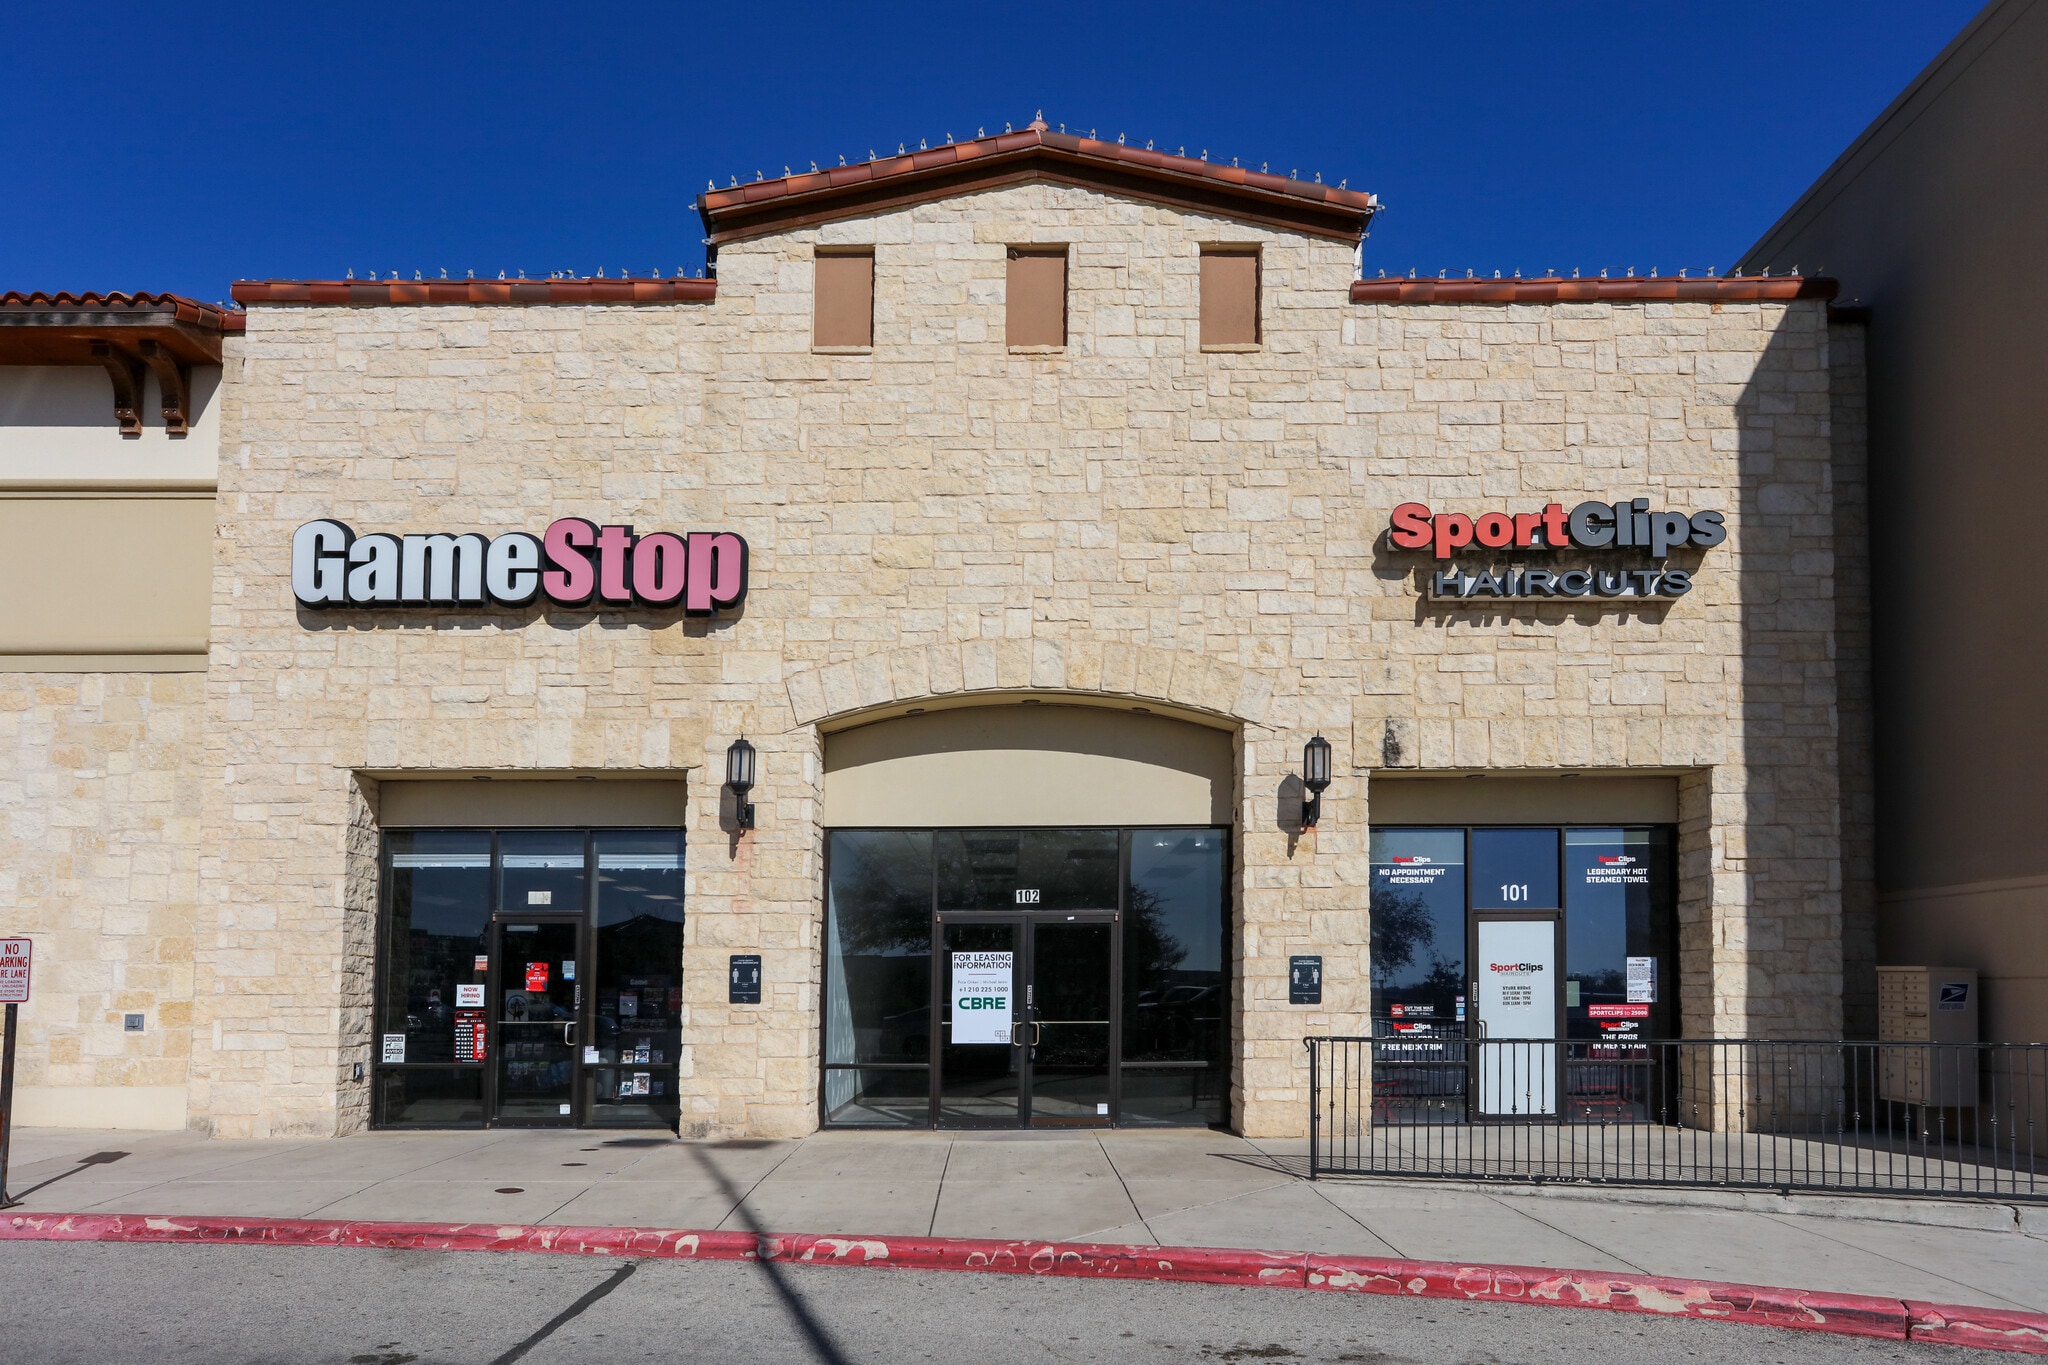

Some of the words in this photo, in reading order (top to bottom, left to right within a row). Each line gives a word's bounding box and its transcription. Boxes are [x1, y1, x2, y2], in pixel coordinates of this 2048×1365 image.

[291, 517, 749, 617] GameStop
[1434, 569, 1693, 596] HAIRCUTS
[1379, 868, 1390, 876] NO
[1391, 868, 1446, 876] APPOINTMENT
[1390, 876, 1435, 884] NECESSARY
[1018, 890, 1039, 902] 102
[1501, 885, 1528, 901] 101
[5, 944, 19, 954] NO
[0, 957, 27, 967] ARKING
[954, 954, 971, 962] FOR
[974, 954, 1012, 962] LEASING
[0, 970, 8, 978] RE
[11, 970, 26, 978] LANE
[959, 997, 1006, 1009] CBRE
[1381, 1043, 1401, 1051] FREE
[1424, 1043, 1443, 1051] TRIM
